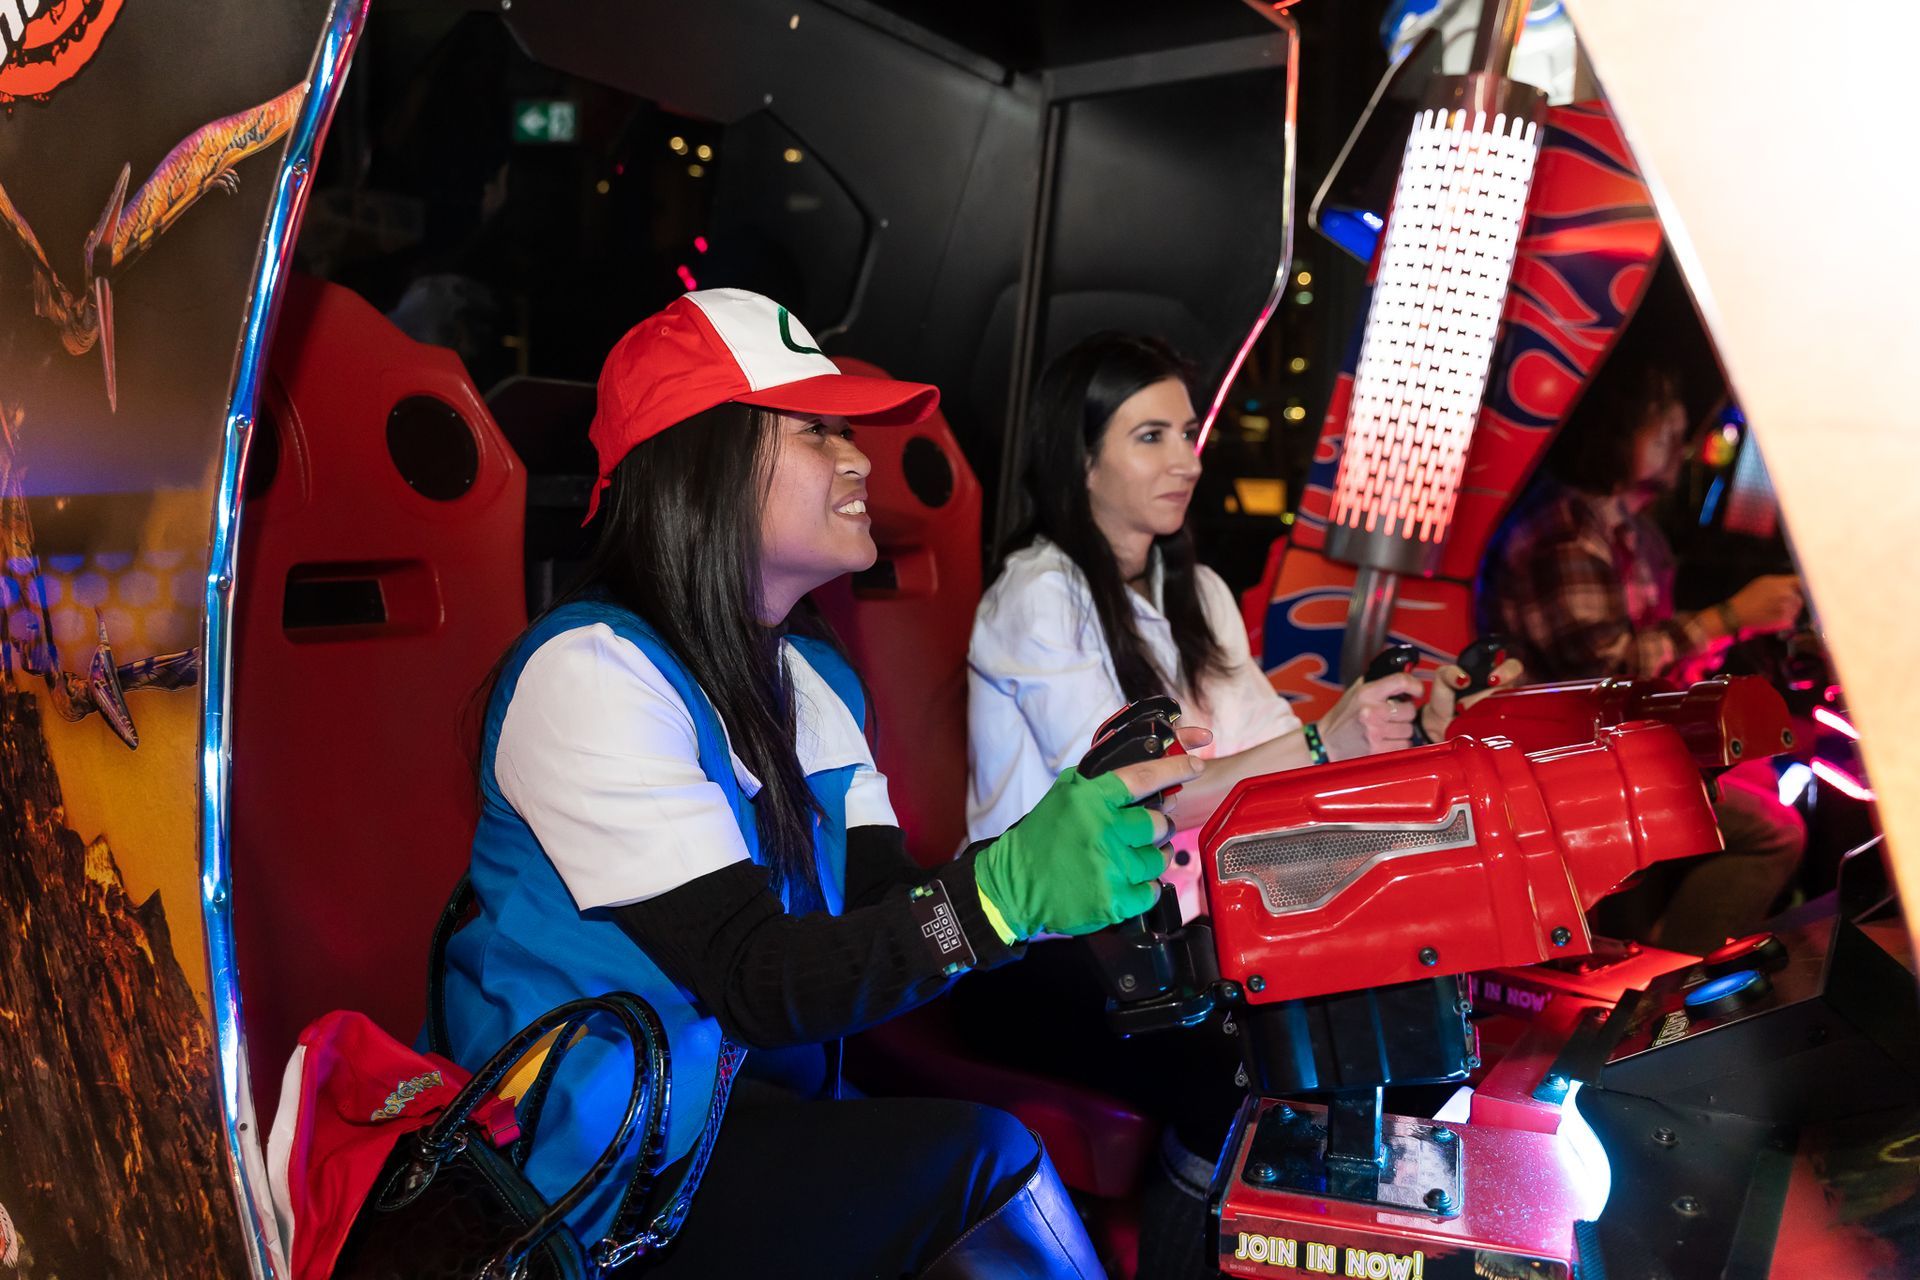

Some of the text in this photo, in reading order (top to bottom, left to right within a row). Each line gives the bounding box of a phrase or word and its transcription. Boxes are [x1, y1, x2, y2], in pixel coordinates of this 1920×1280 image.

[933, 921, 950, 950] REC
[937, 906, 958, 945] ROOM
[1235, 1232, 1425, 1280] JOIN IN NOW!
